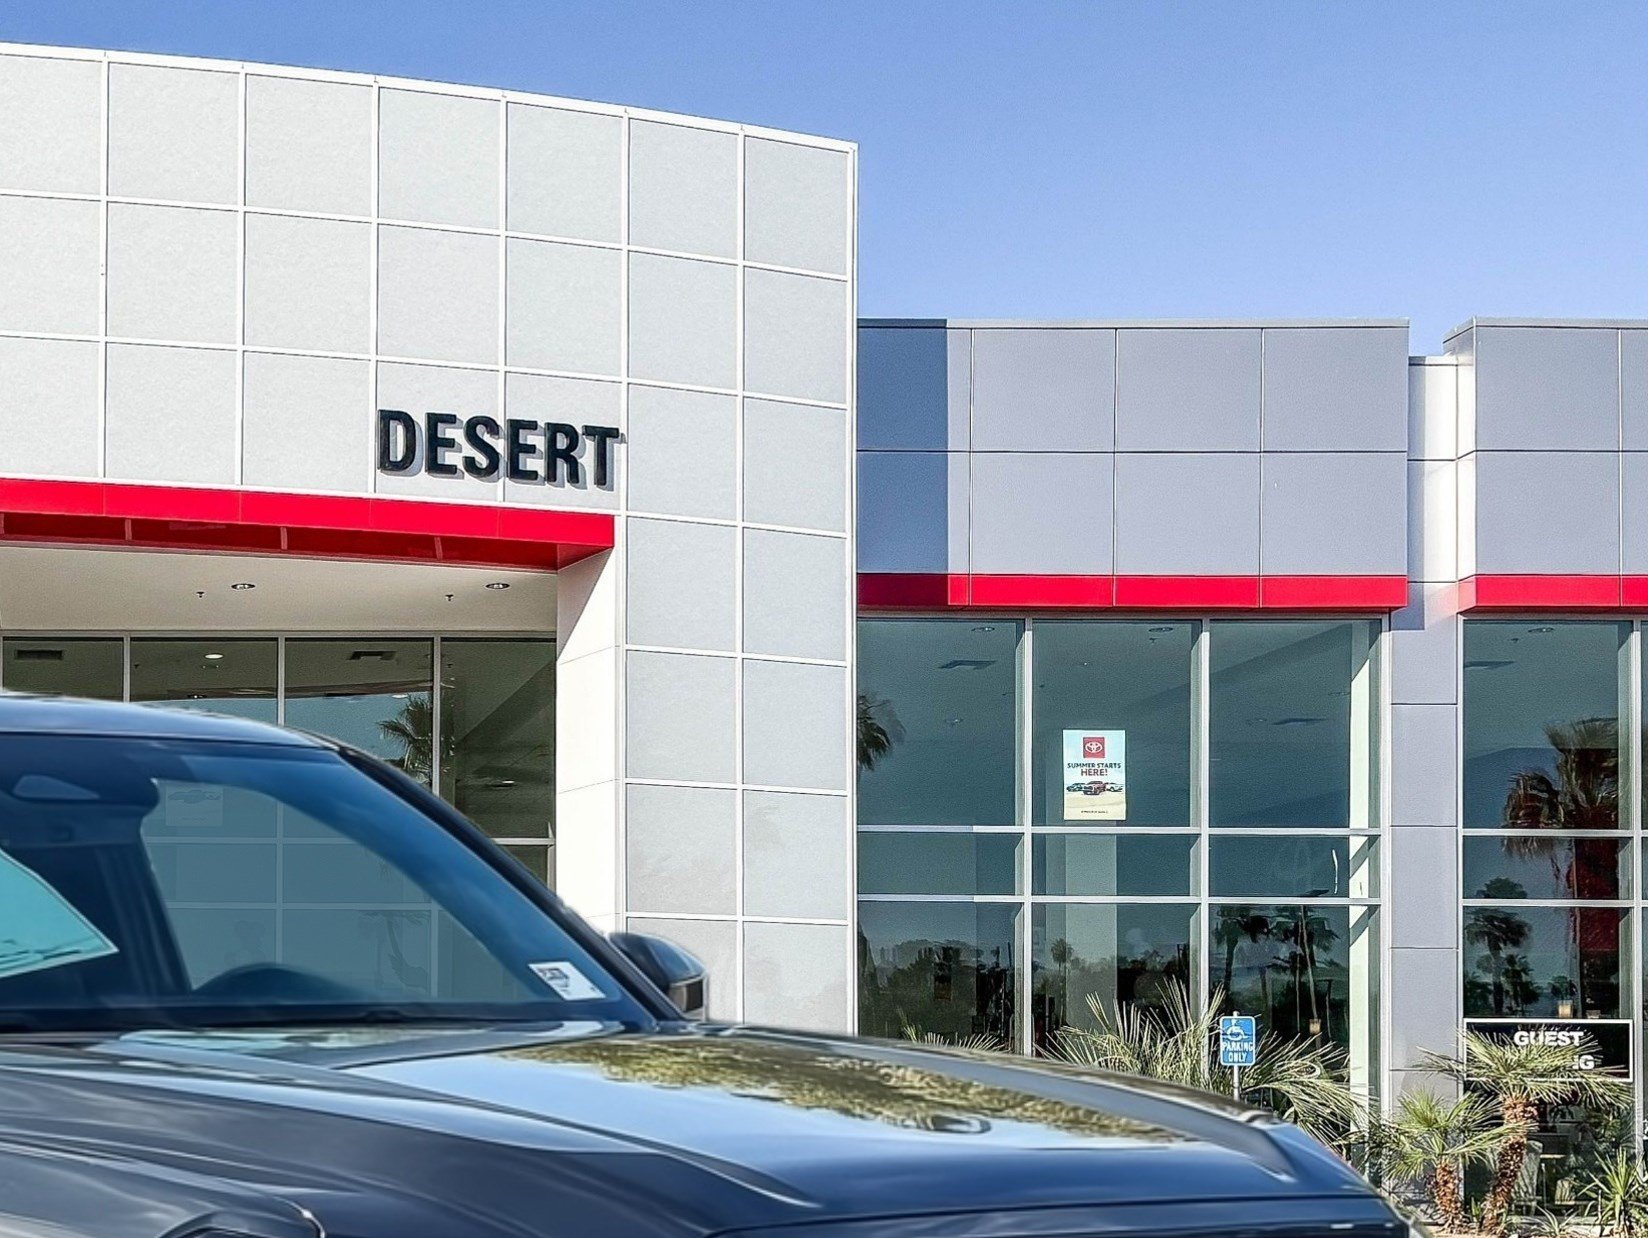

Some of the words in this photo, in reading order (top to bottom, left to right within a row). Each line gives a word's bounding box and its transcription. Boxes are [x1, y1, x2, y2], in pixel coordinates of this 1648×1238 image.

[377, 409, 620, 487] DESERT
[1080, 768, 1108, 776] HERE!
[1513, 1031, 1584, 1047] GUEST
[1222, 1041, 1253, 1052] PARKING
[1228, 1052, 1247, 1063] ONLY
